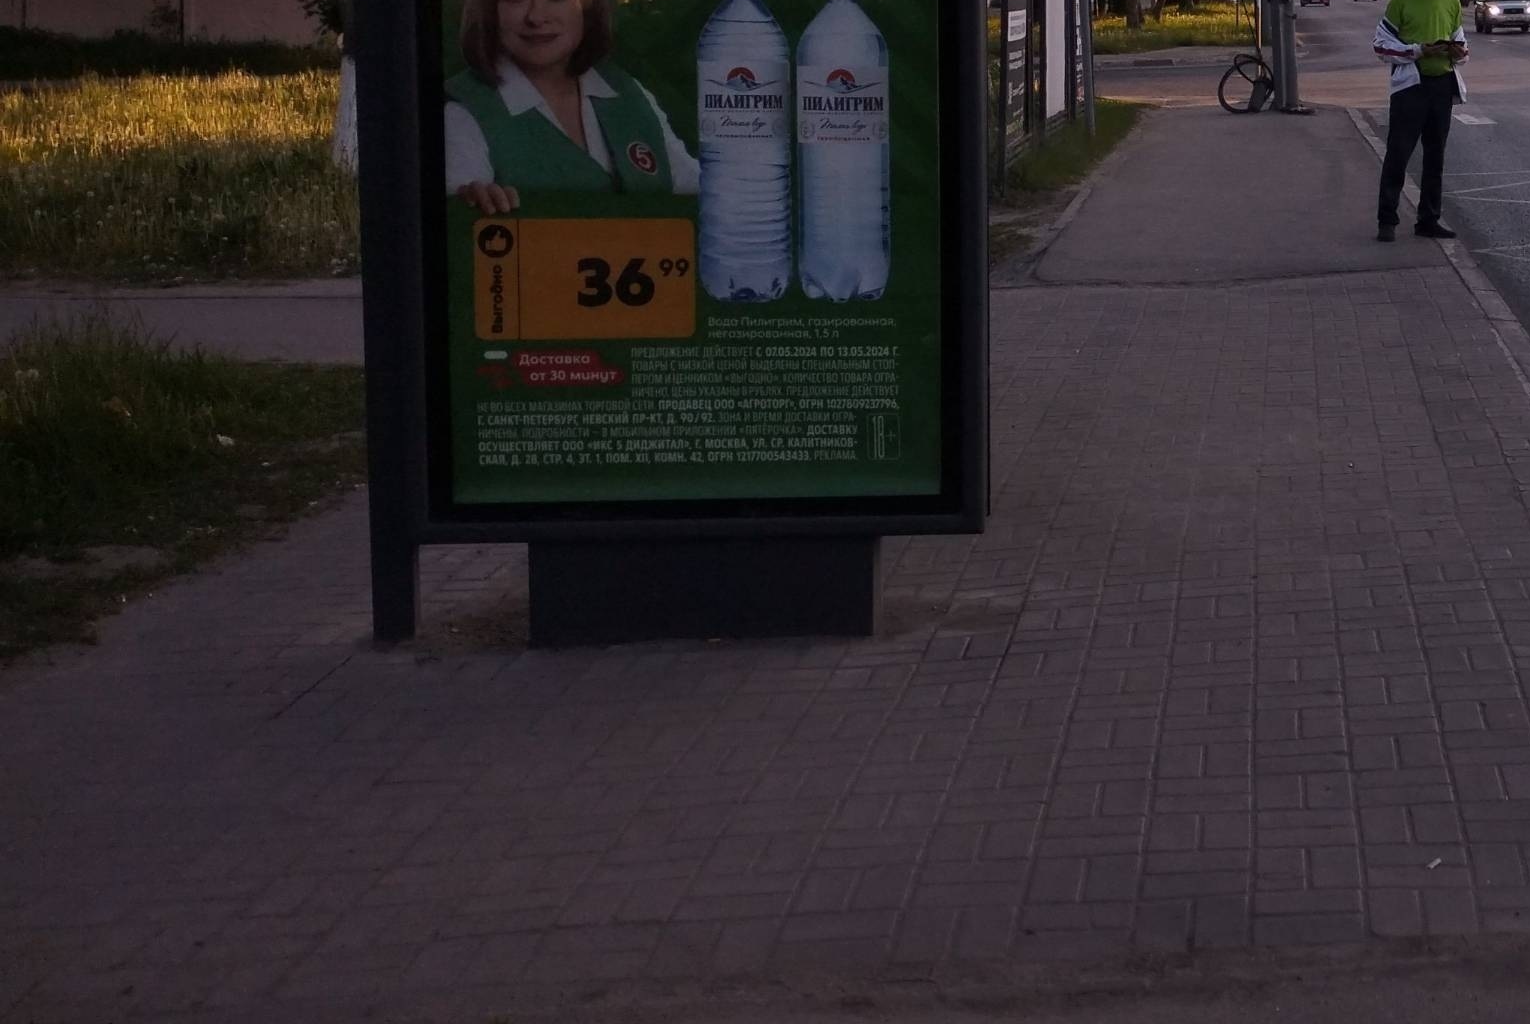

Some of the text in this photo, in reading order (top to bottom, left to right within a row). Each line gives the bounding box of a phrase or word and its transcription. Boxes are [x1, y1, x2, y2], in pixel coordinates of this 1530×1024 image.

[704, 93, 784, 110] ПИЛИГРИМ
[803, 96, 884, 112] ПИЛИГРИМ
[577, 257, 655, 307] 36
[490, 264, 503, 334] Выгодно
[707, 317, 897, 330] Вода Пилигрим, газированная,
[837, 347, 889, 358] 13.05.2024
[519, 354, 591, 367] Доставка
[530, 370, 618, 384] от 30 минут
[657, 401, 713, 412] ПРОДАВЕЦ
[713, 400, 736, 411] ООО
[798, 400, 824, 411] ОГРН
[582, 414, 630, 425] НЕВСКИЙ
[805, 425, 858, 436] ДОСТАВКУ
[872, 416, 896, 460] 18+
[477, 441, 561, 452] ОСУЩЕСТВЛЯЕТ
[561, 441, 585, 452] ООО
[706, 452, 734, 463] ОГРН
